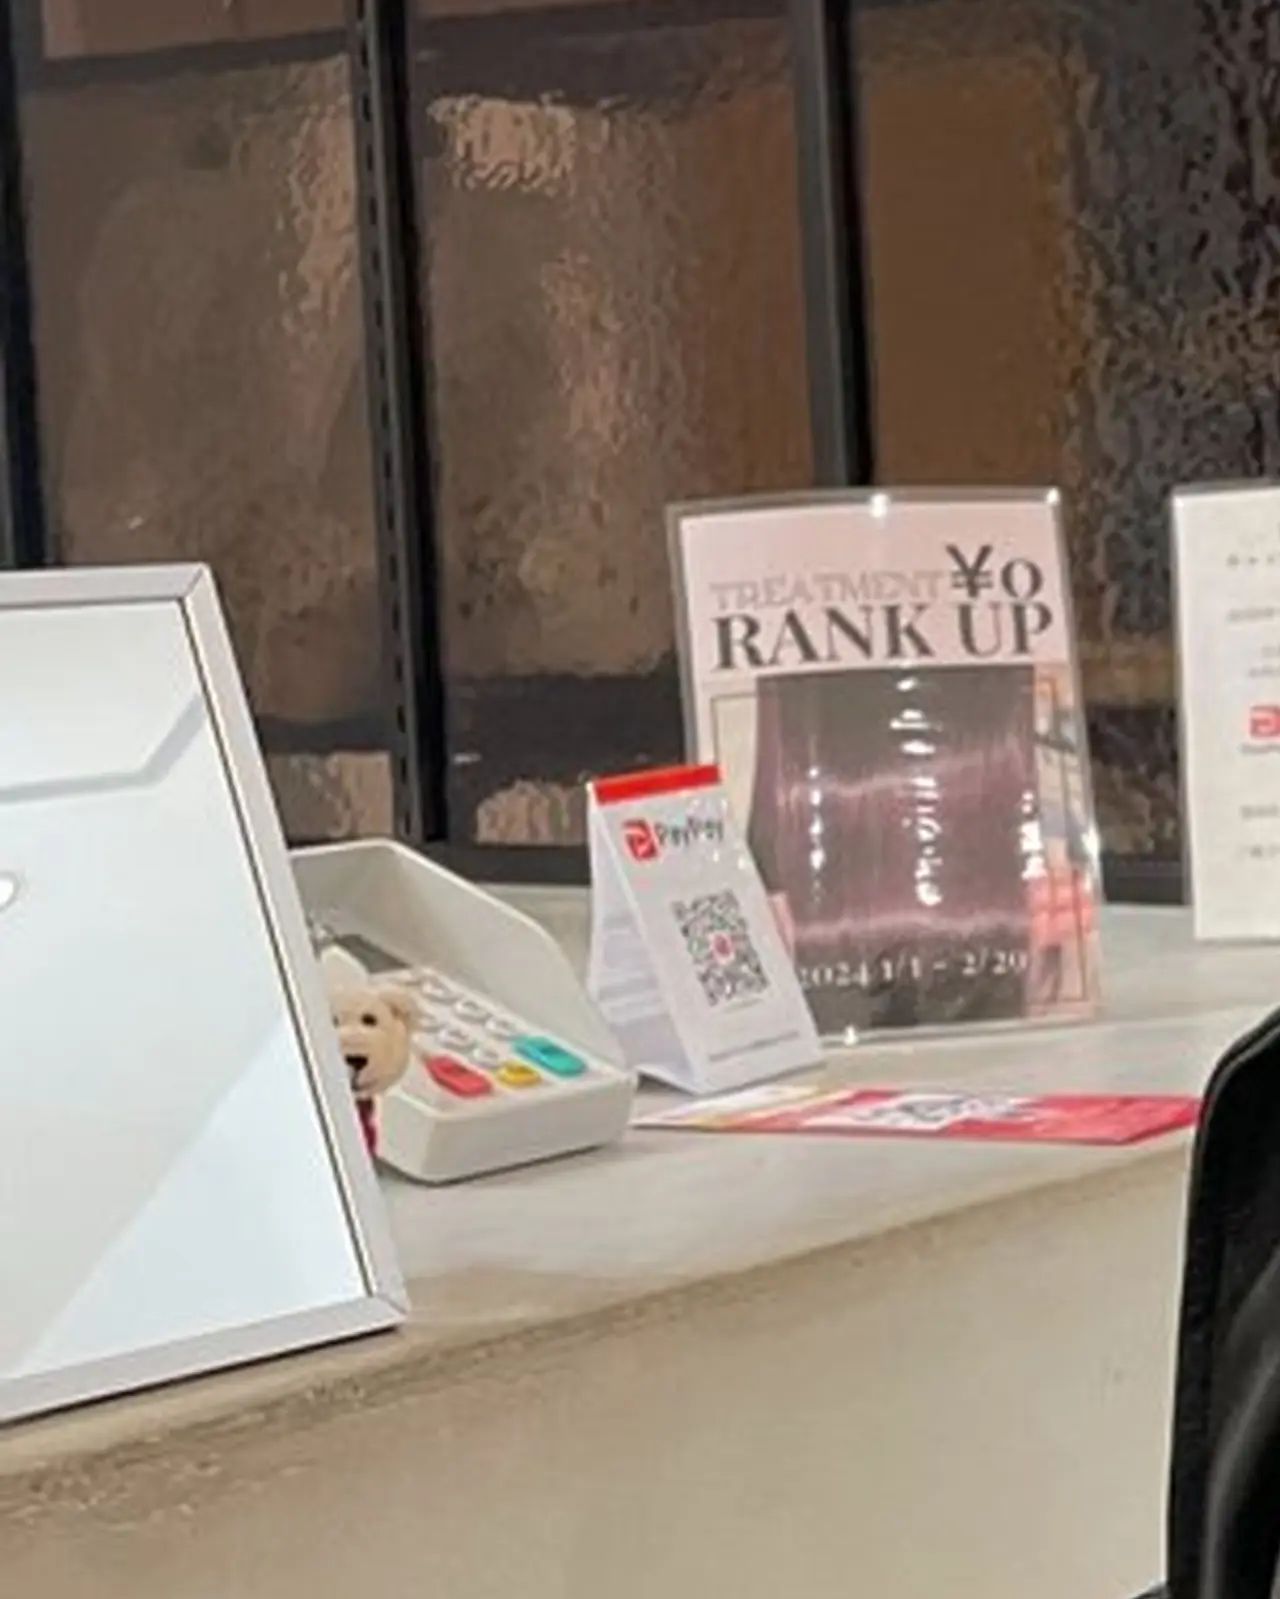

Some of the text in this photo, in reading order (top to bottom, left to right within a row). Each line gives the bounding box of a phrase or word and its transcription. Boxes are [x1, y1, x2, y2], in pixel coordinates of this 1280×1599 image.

[708, 569, 943, 610] TREATMENT
[710, 601, 1053, 671] RANK UP
